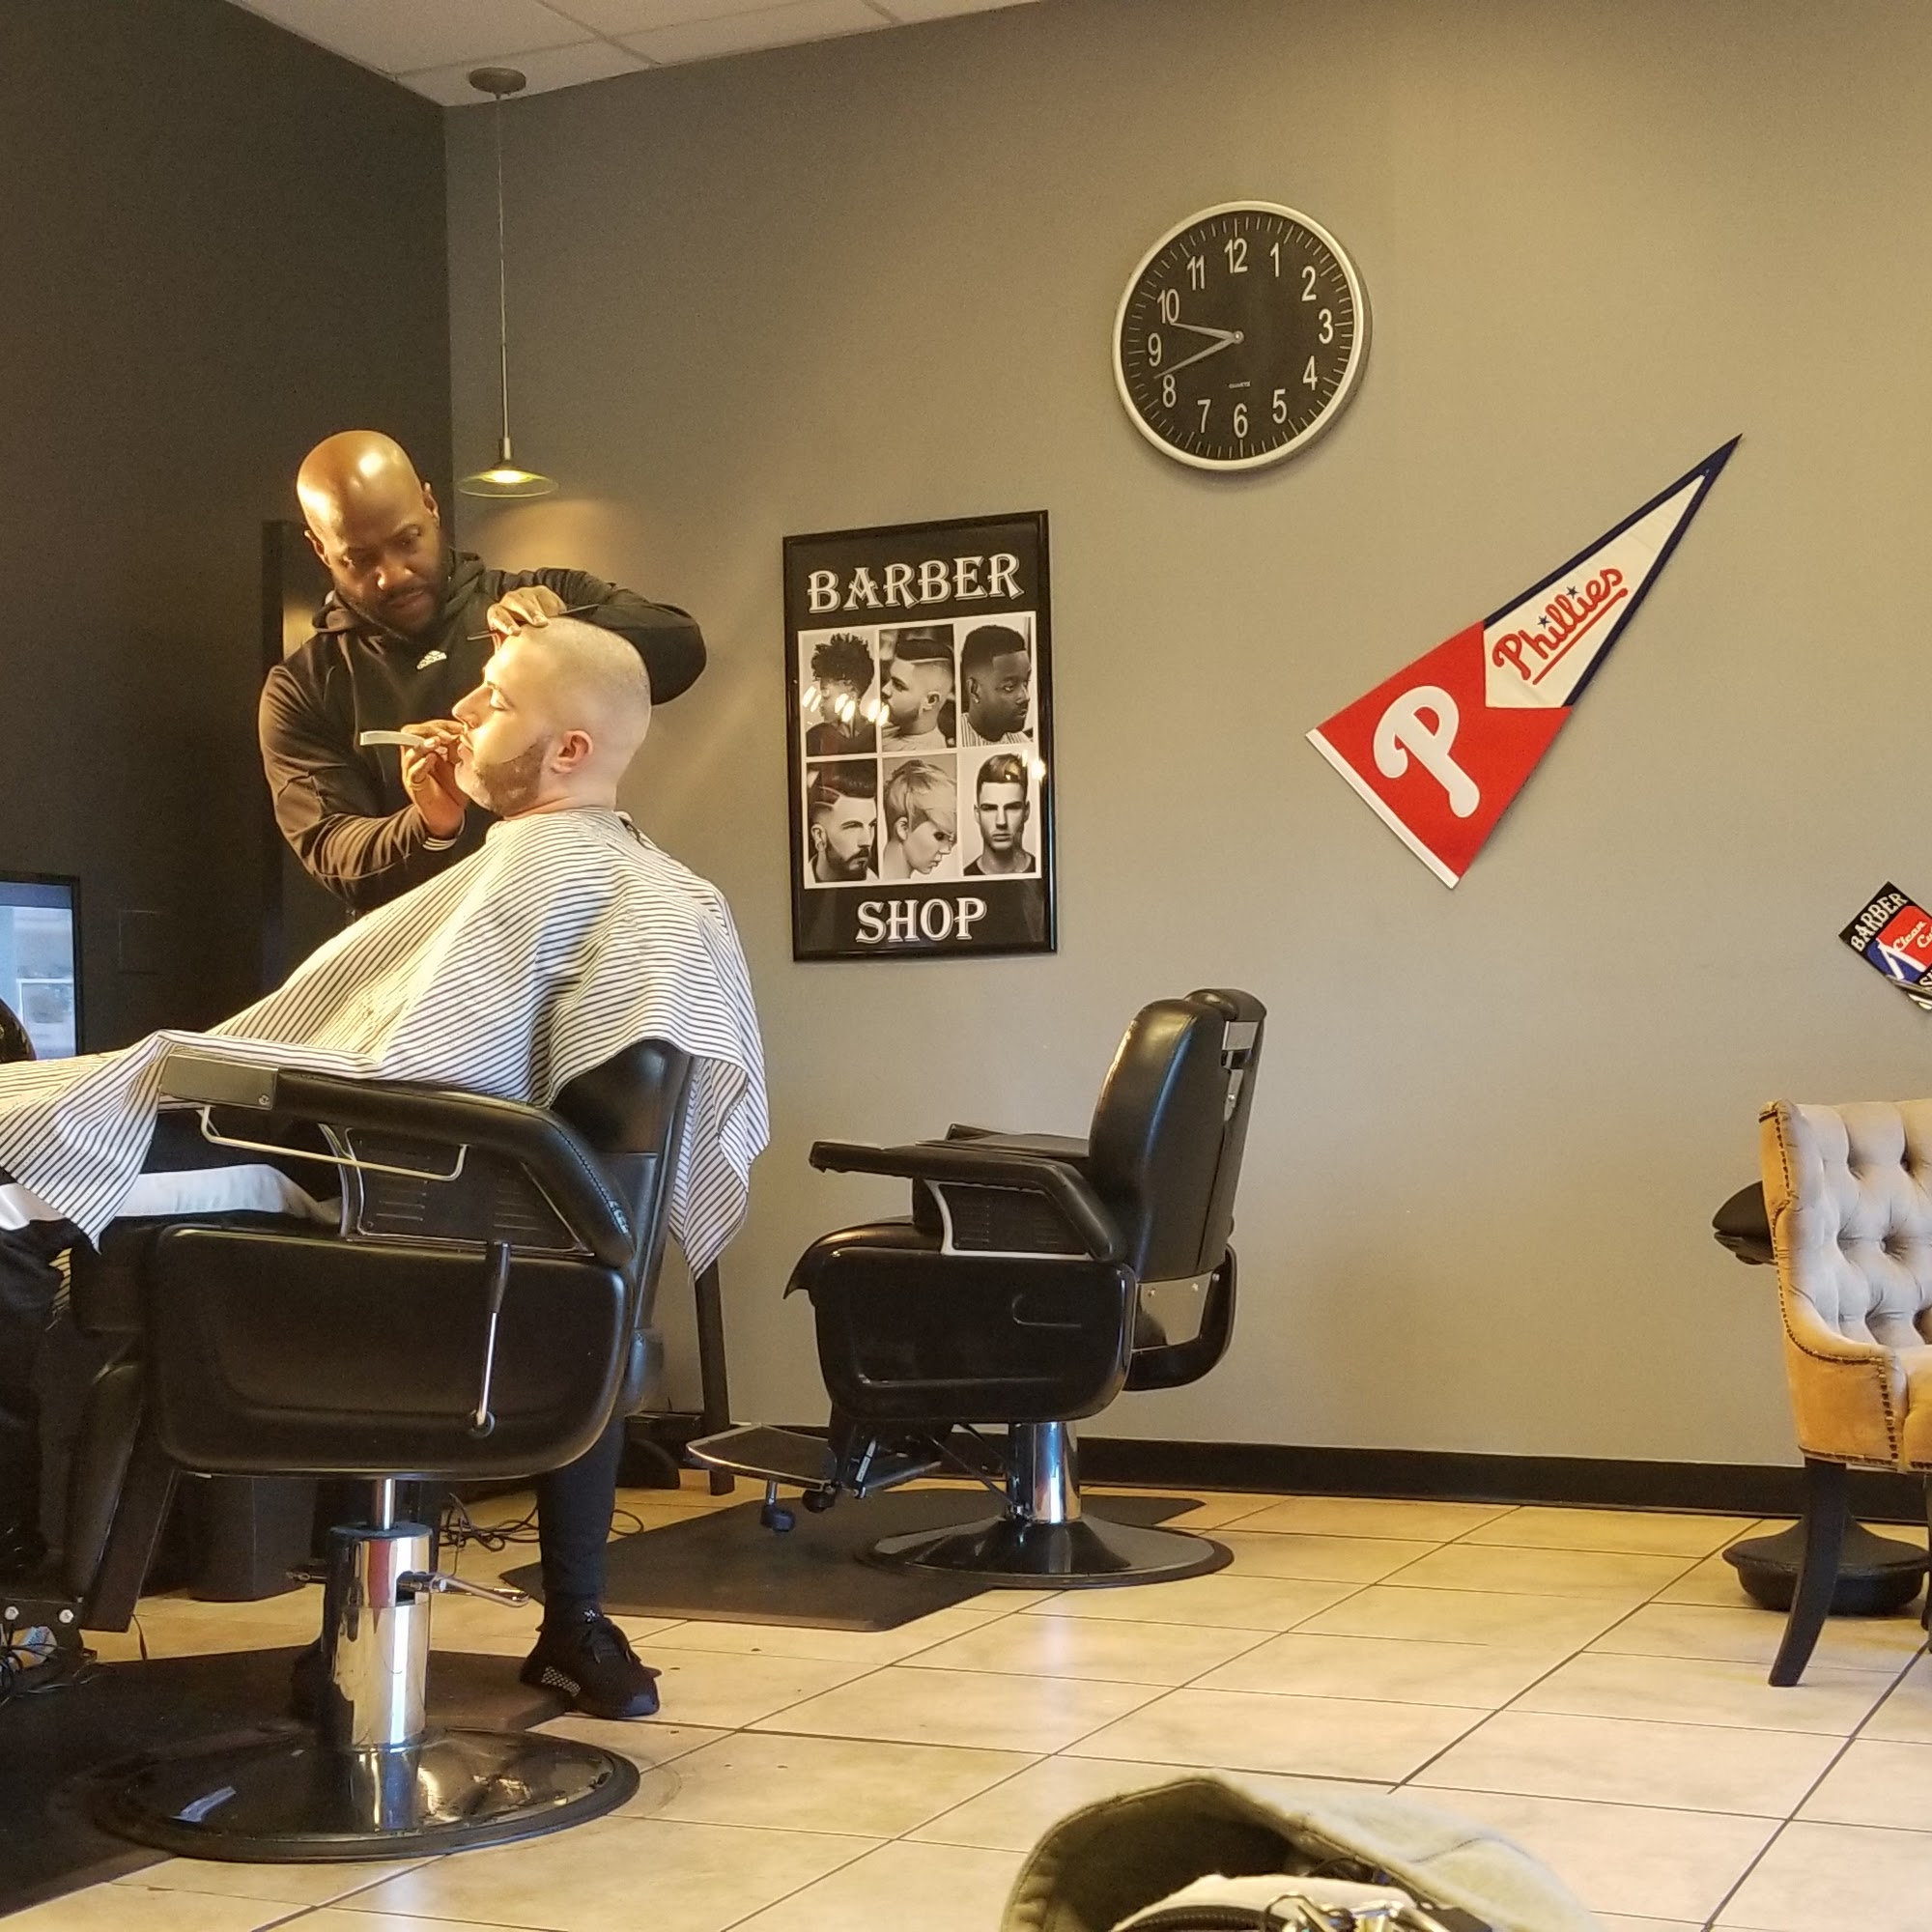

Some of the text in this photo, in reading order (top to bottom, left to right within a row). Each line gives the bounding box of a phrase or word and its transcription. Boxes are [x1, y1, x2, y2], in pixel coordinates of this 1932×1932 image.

[1186, 255, 1206, 290] 11
[1224, 238, 1248, 273] 12
[1270, 242, 1280, 277] 1
[1301, 266, 1317, 301] 2
[1157, 289, 1179, 324] 10
[1319, 308, 1333, 344] 3
[1148, 333, 1161, 366] 9
[1303, 355, 1318, 390] 4
[1162, 374, 1177, 408] 8
[1272, 388, 1288, 424] 5
[1197, 399, 1210, 433] 7
[1234, 403, 1248, 438] 6
[806, 552, 1025, 614] BARBER
[1492, 568, 1623, 681] Phillies
[1373, 685, 1480, 818] P
[855, 896, 987, 944] SHOP
[1850, 893, 1909, 952] BARBER
